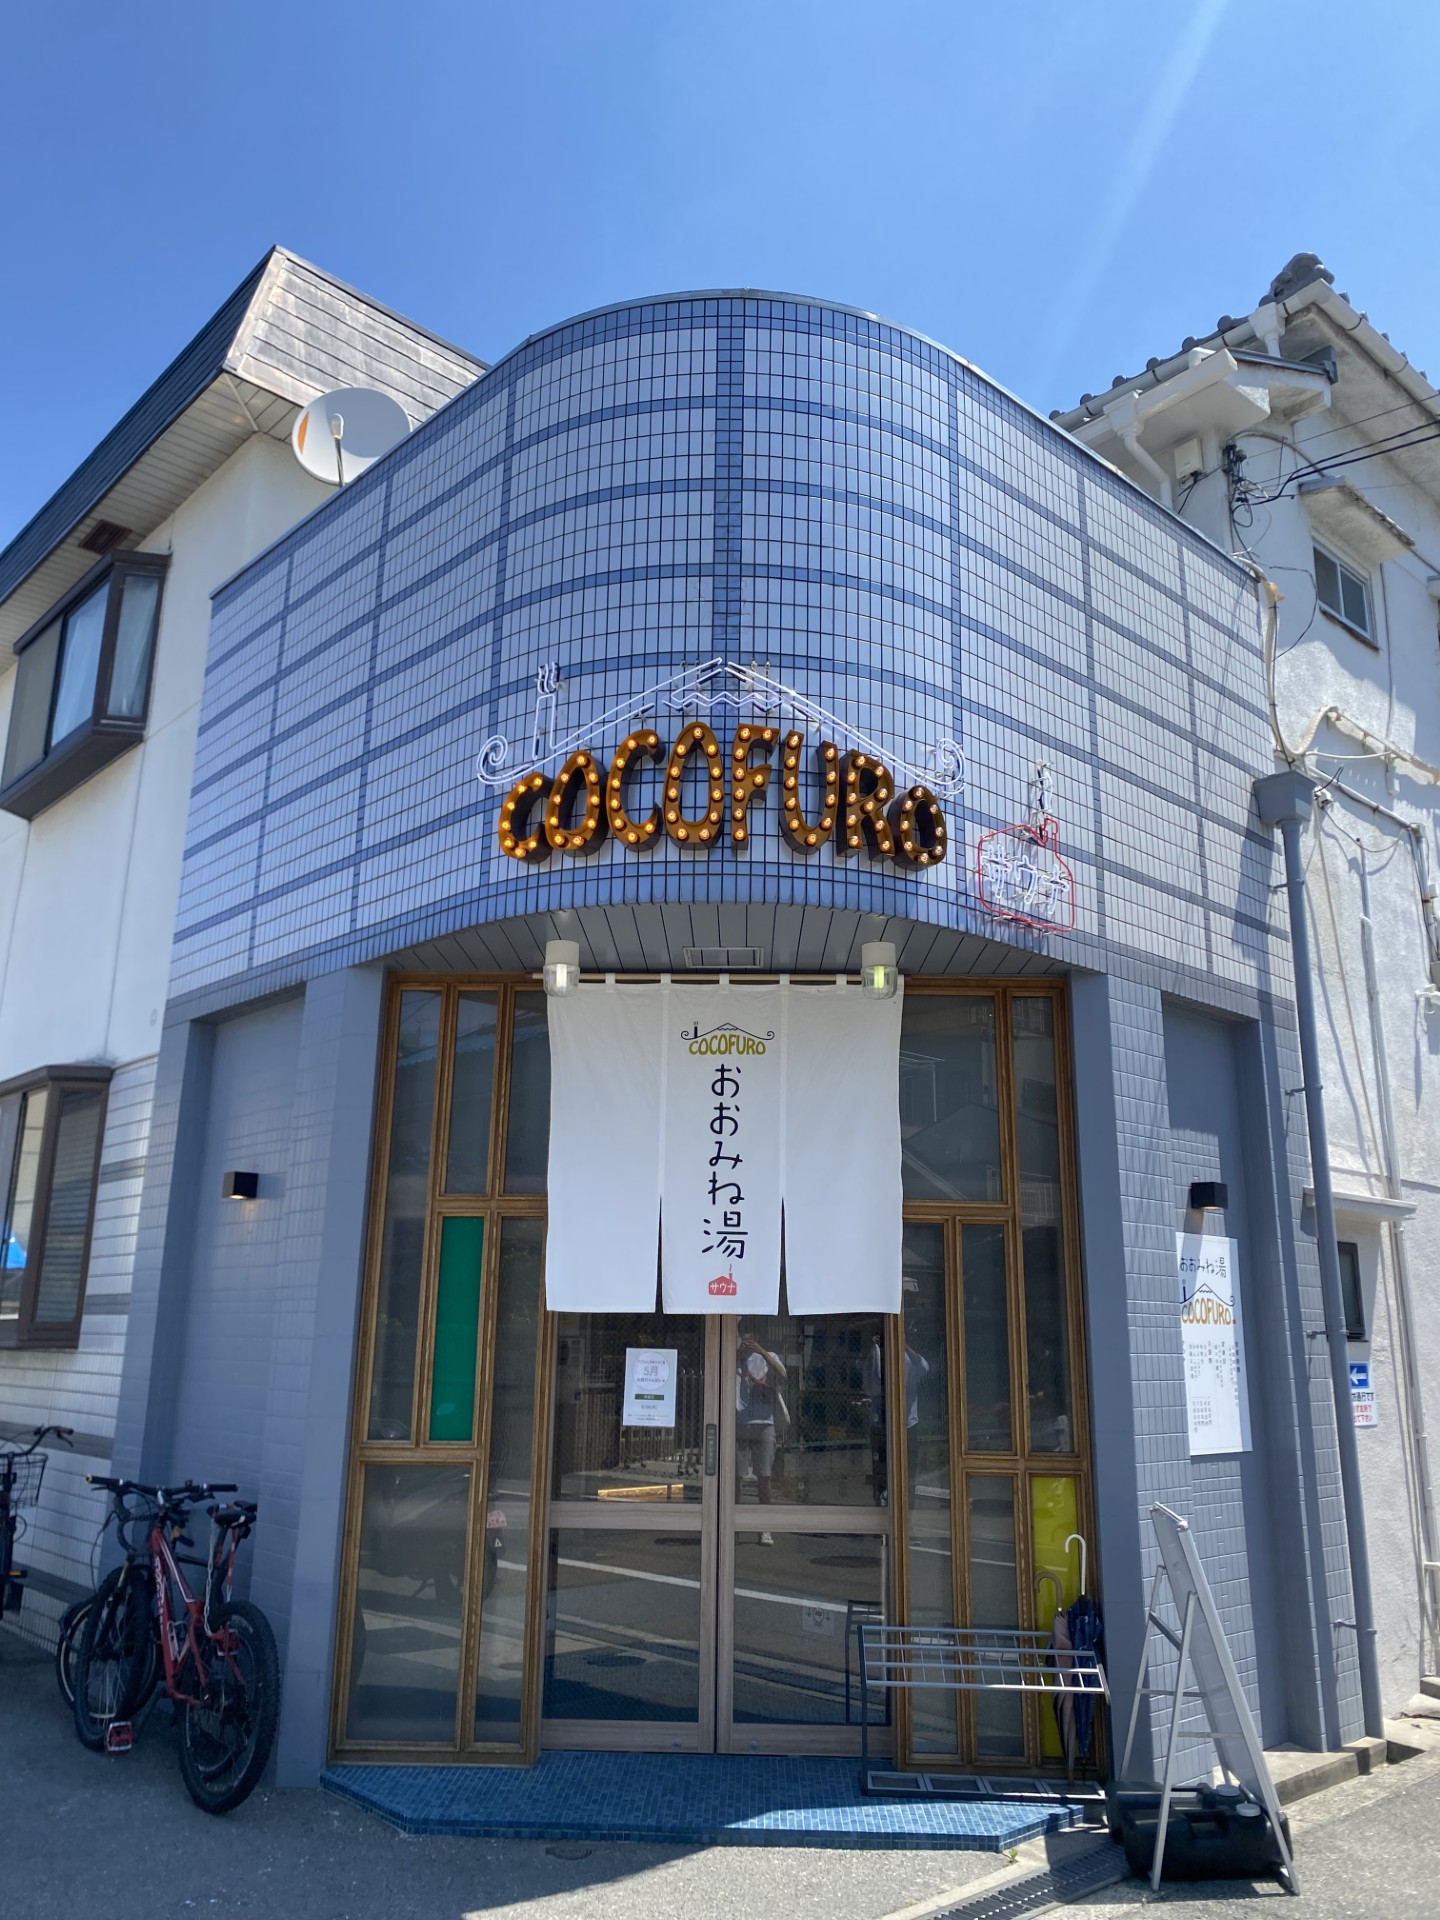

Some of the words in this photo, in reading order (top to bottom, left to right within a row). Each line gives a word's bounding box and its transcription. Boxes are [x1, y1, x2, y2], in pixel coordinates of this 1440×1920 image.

[499, 721, 948, 868] COCOFURO
[980, 843, 1070, 915] サウナ
[688, 1033, 766, 1056] COCOFURO
[701, 1063, 749, 1259] おおみね湯
[1180, 1256, 1227, 1278] おおみね湯
[709, 1282, 737, 1294] サウナ
[1181, 1297, 1232, 1325] COCOFURO
